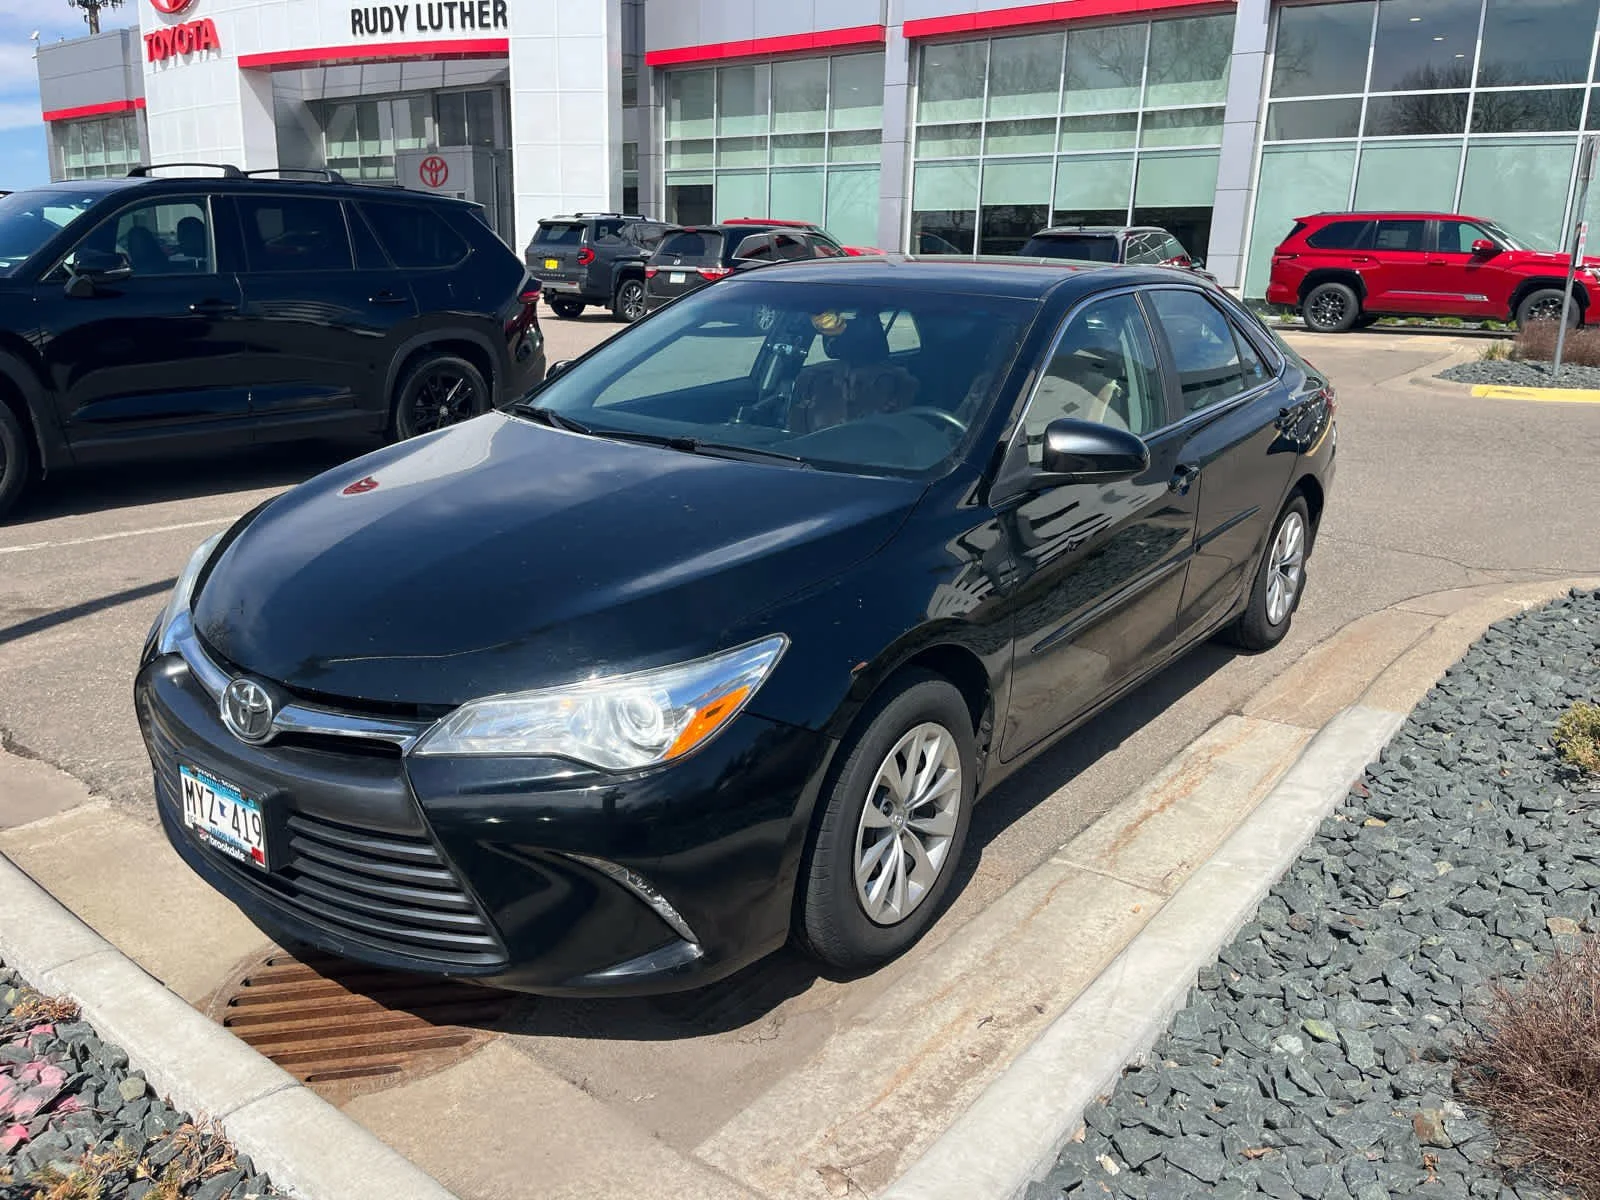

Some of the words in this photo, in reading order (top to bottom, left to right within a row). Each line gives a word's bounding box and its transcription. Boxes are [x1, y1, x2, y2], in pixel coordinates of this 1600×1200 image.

[351, 5, 408, 35] RUDY
[416, 0, 508, 31] LUTHER
[144, 18, 220, 63] TOYOTA
[184, 777, 218, 826] MYZ
[231, 803, 262, 847] 419
